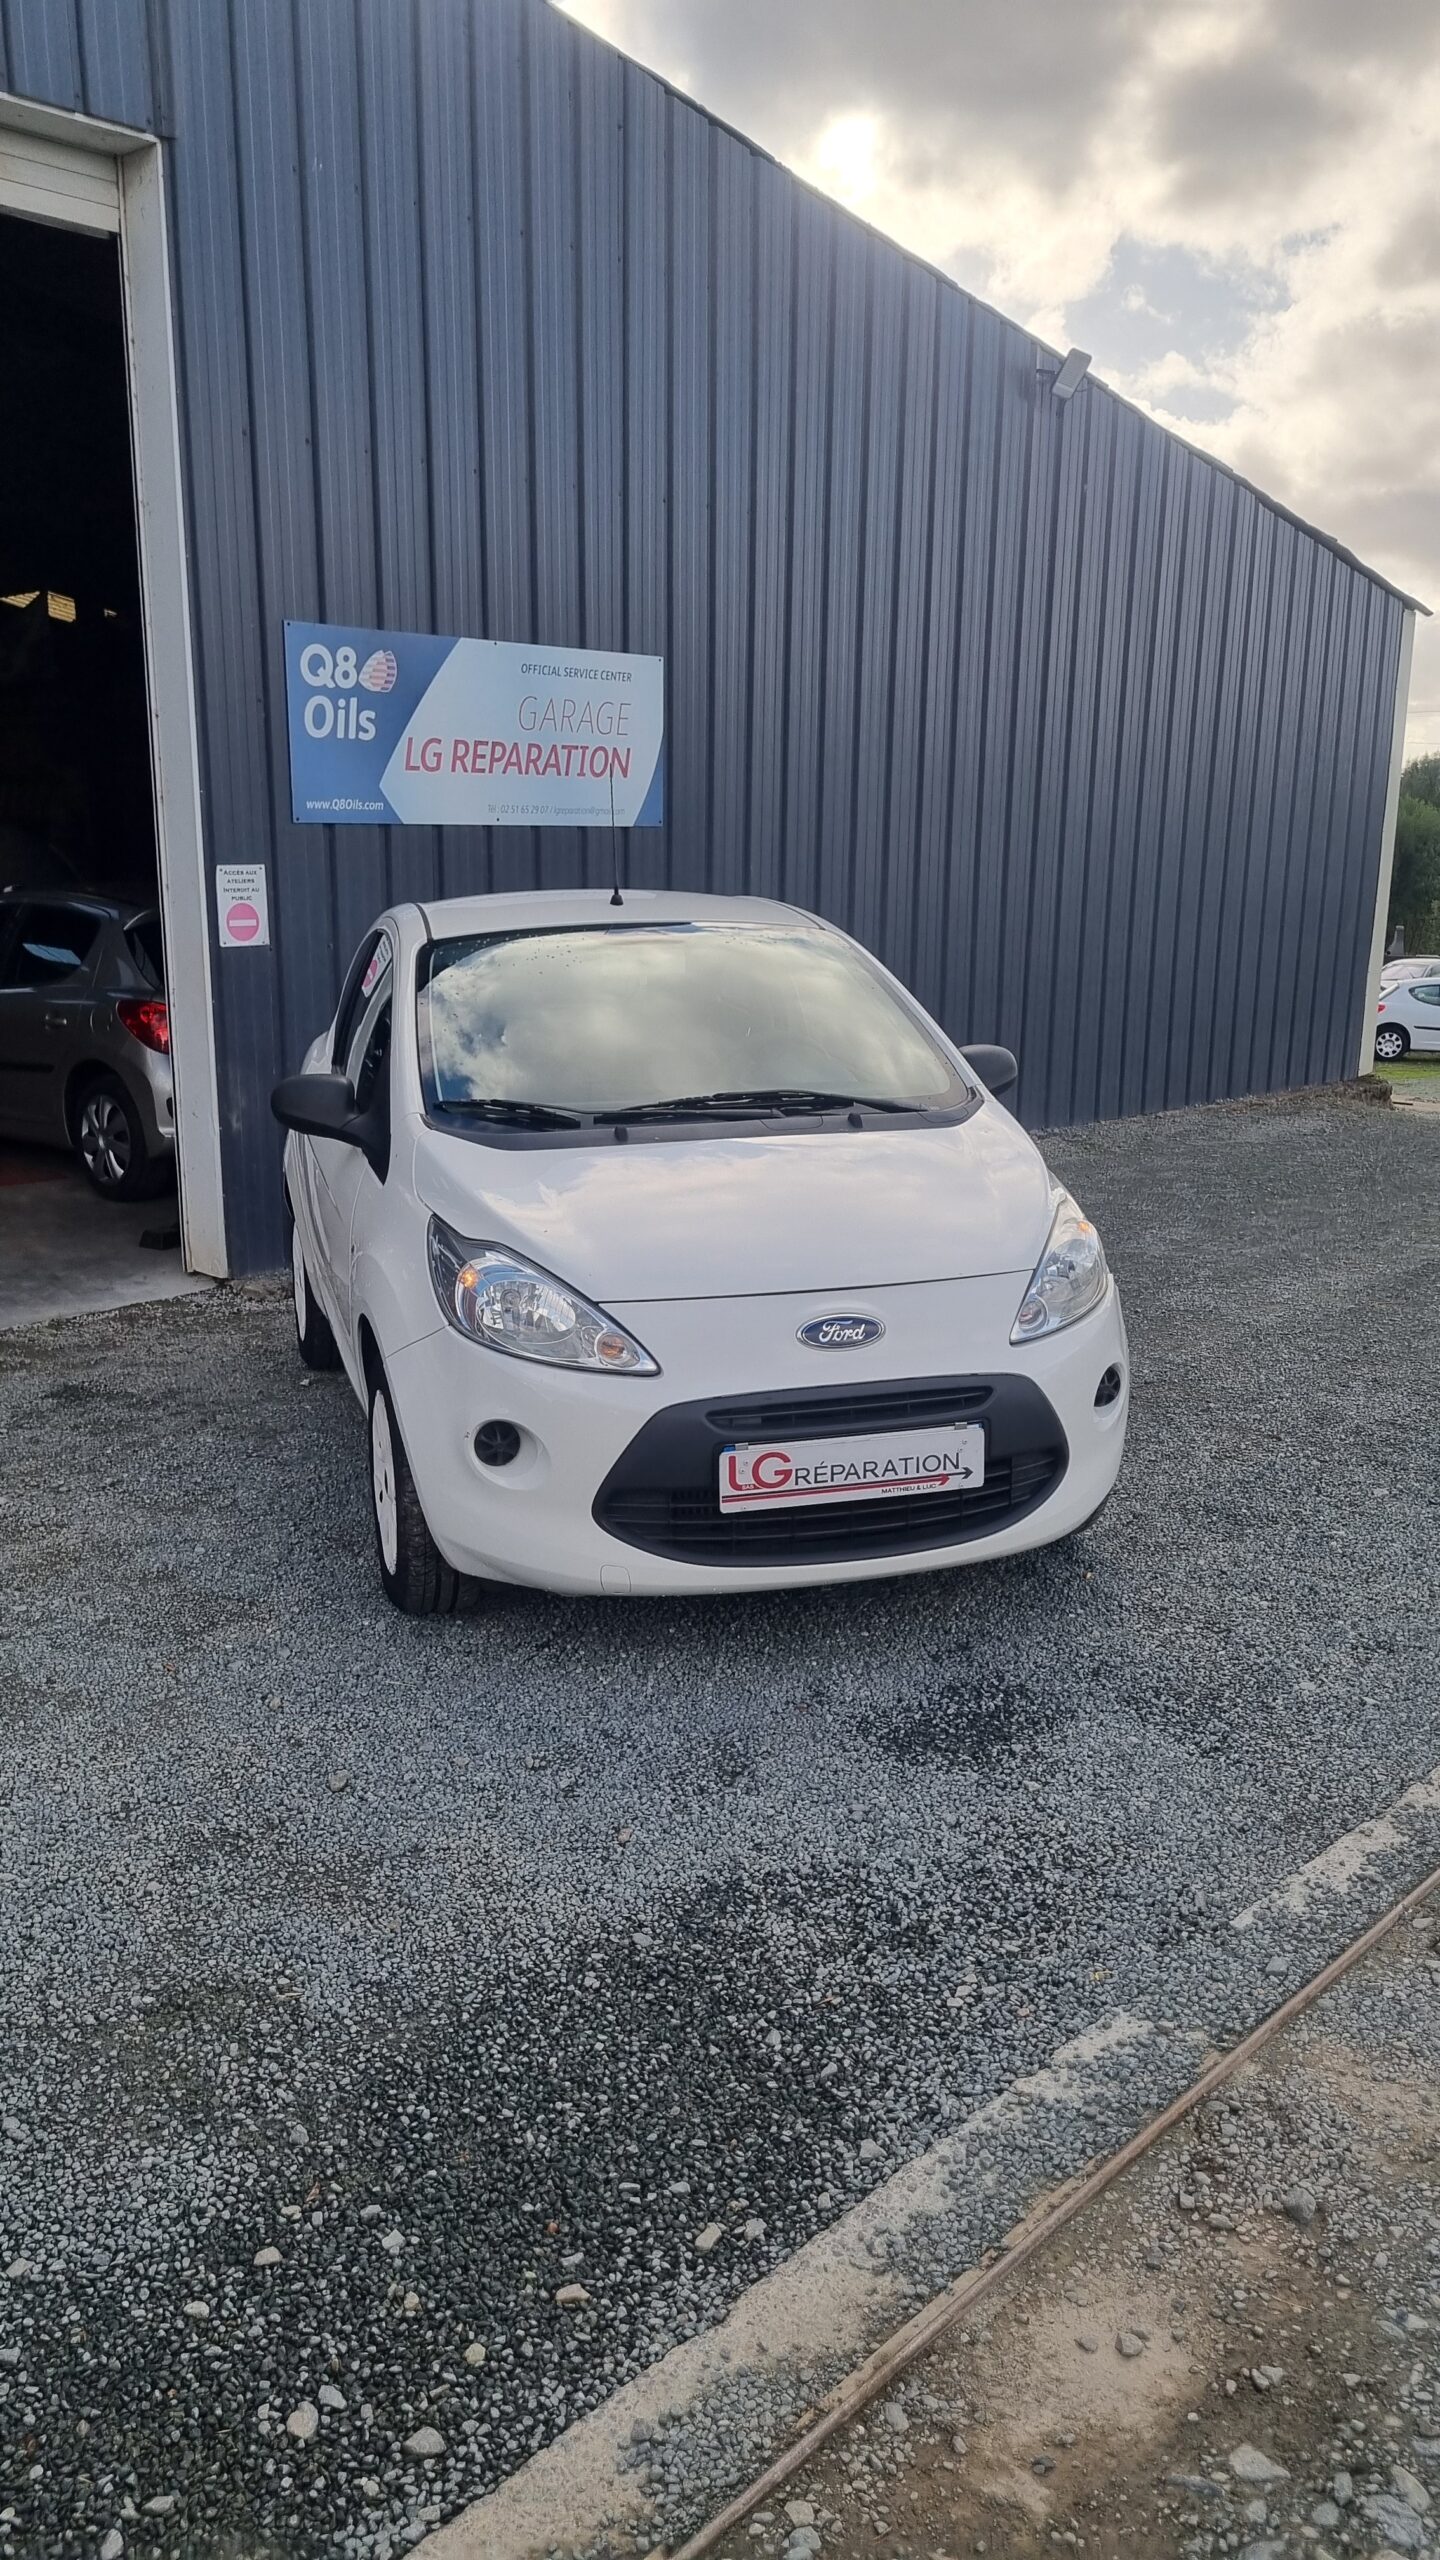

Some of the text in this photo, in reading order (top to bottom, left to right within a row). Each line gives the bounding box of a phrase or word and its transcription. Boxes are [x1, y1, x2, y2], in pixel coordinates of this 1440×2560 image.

[299, 643, 358, 690] Q8
[520, 663, 632, 682] OFFICIAL SERVICE CENTER
[303, 695, 377, 741] Oils
[518, 695, 632, 736] GARAGE
[404, 737, 632, 778] LG REPARATION
[306, 798, 384, 811] www.Q8Oils.com
[818, 1319, 866, 1343] Ford
[728, 1451, 962, 1491] LG RÉPARATION
[881, 1486, 916, 1494] MATTHIEU
